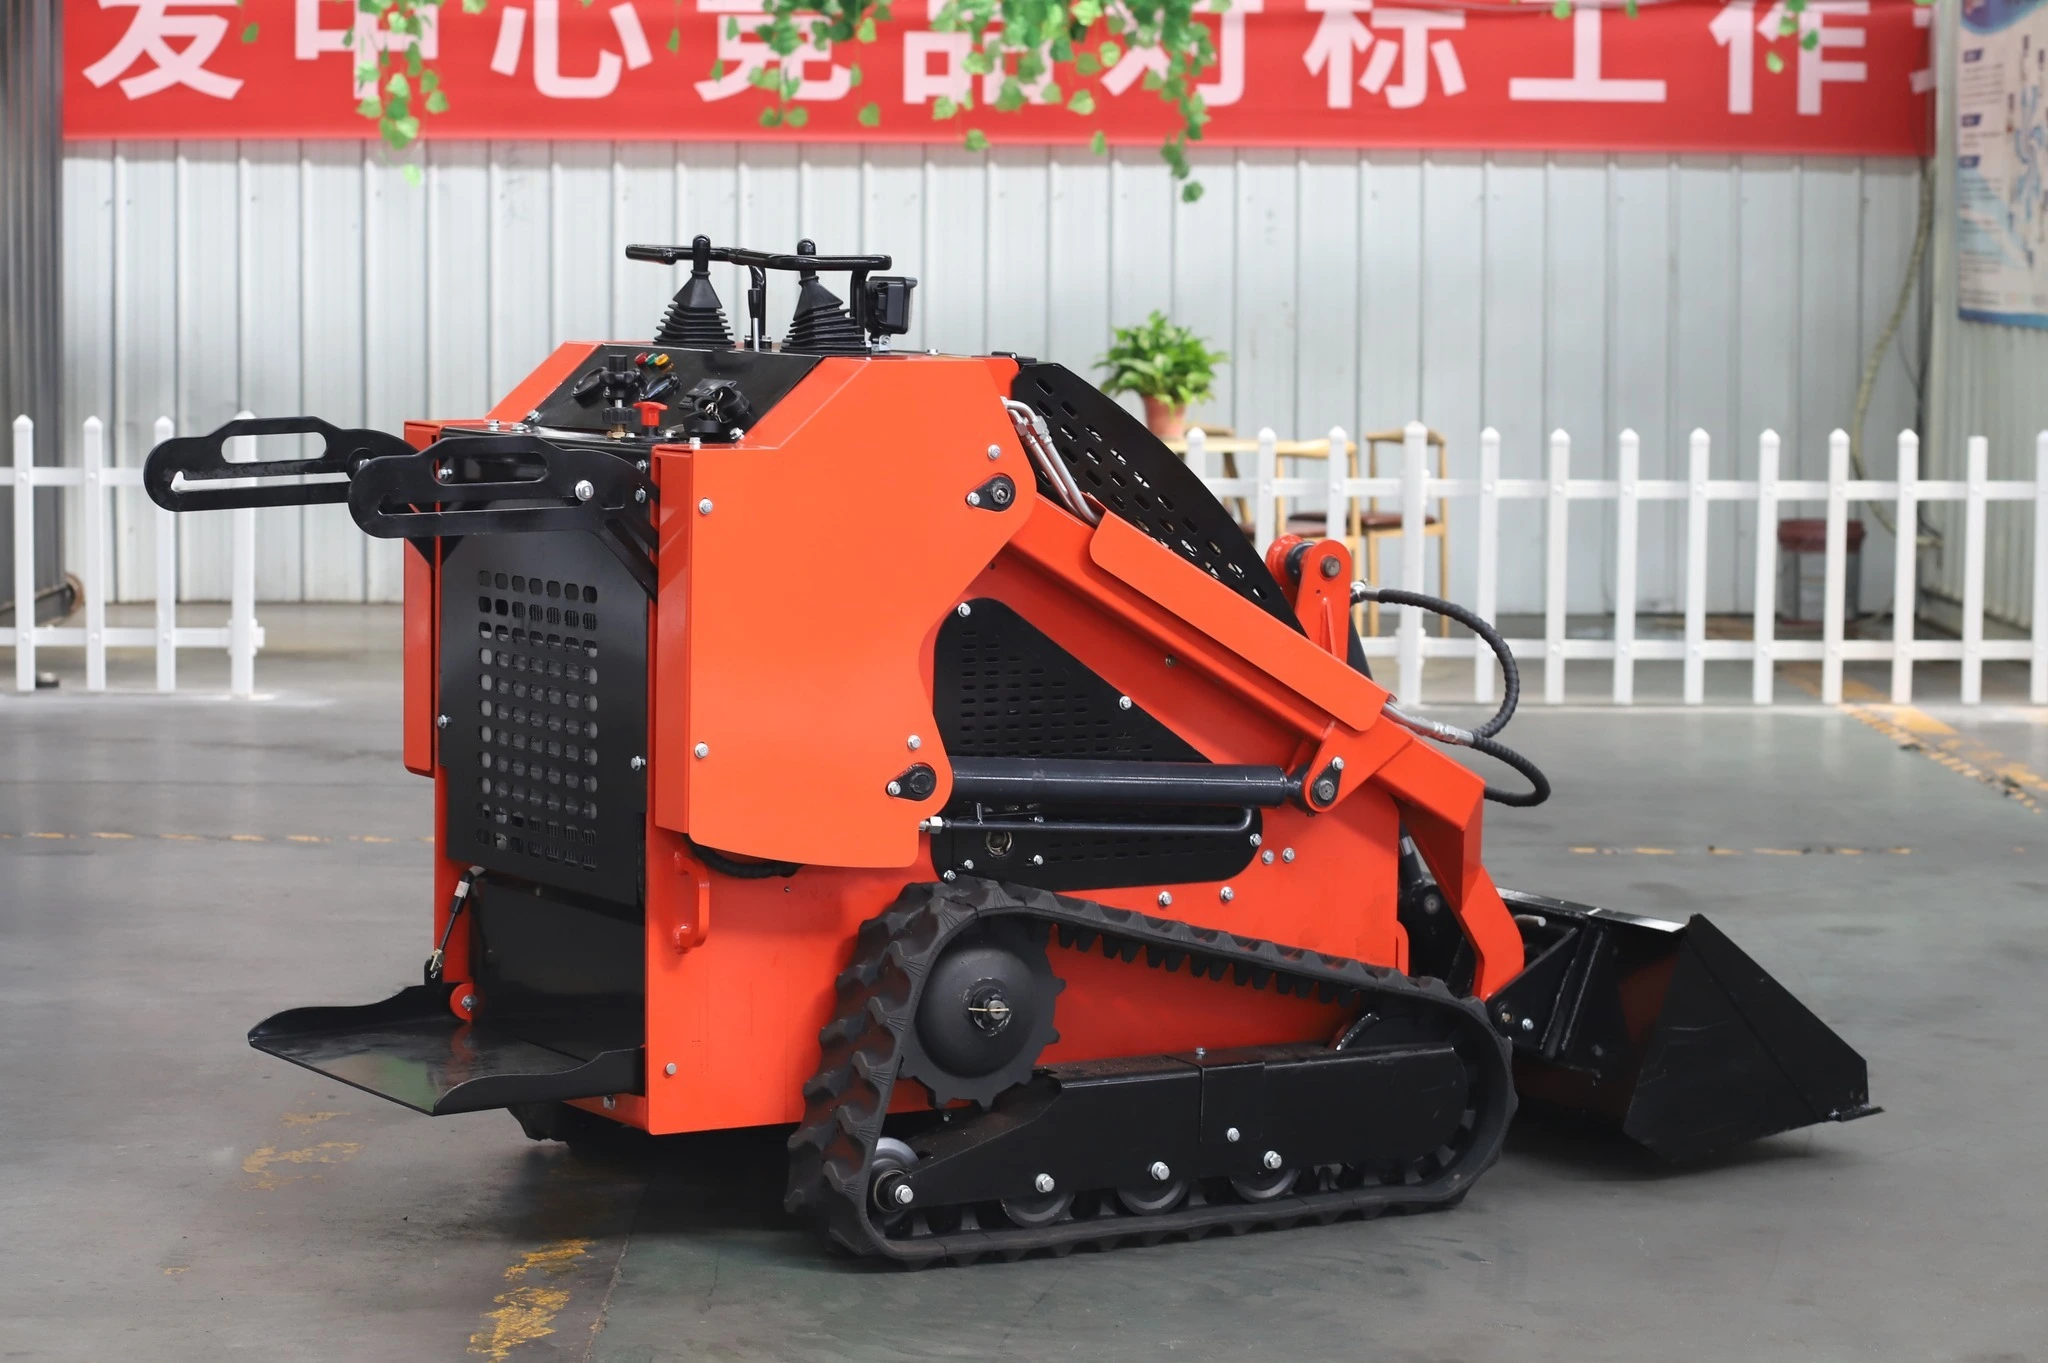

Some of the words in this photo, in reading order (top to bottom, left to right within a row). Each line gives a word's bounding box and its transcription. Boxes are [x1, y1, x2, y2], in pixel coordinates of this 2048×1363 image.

[82, 0, 1936, 116] 发中心竞品对标工作
